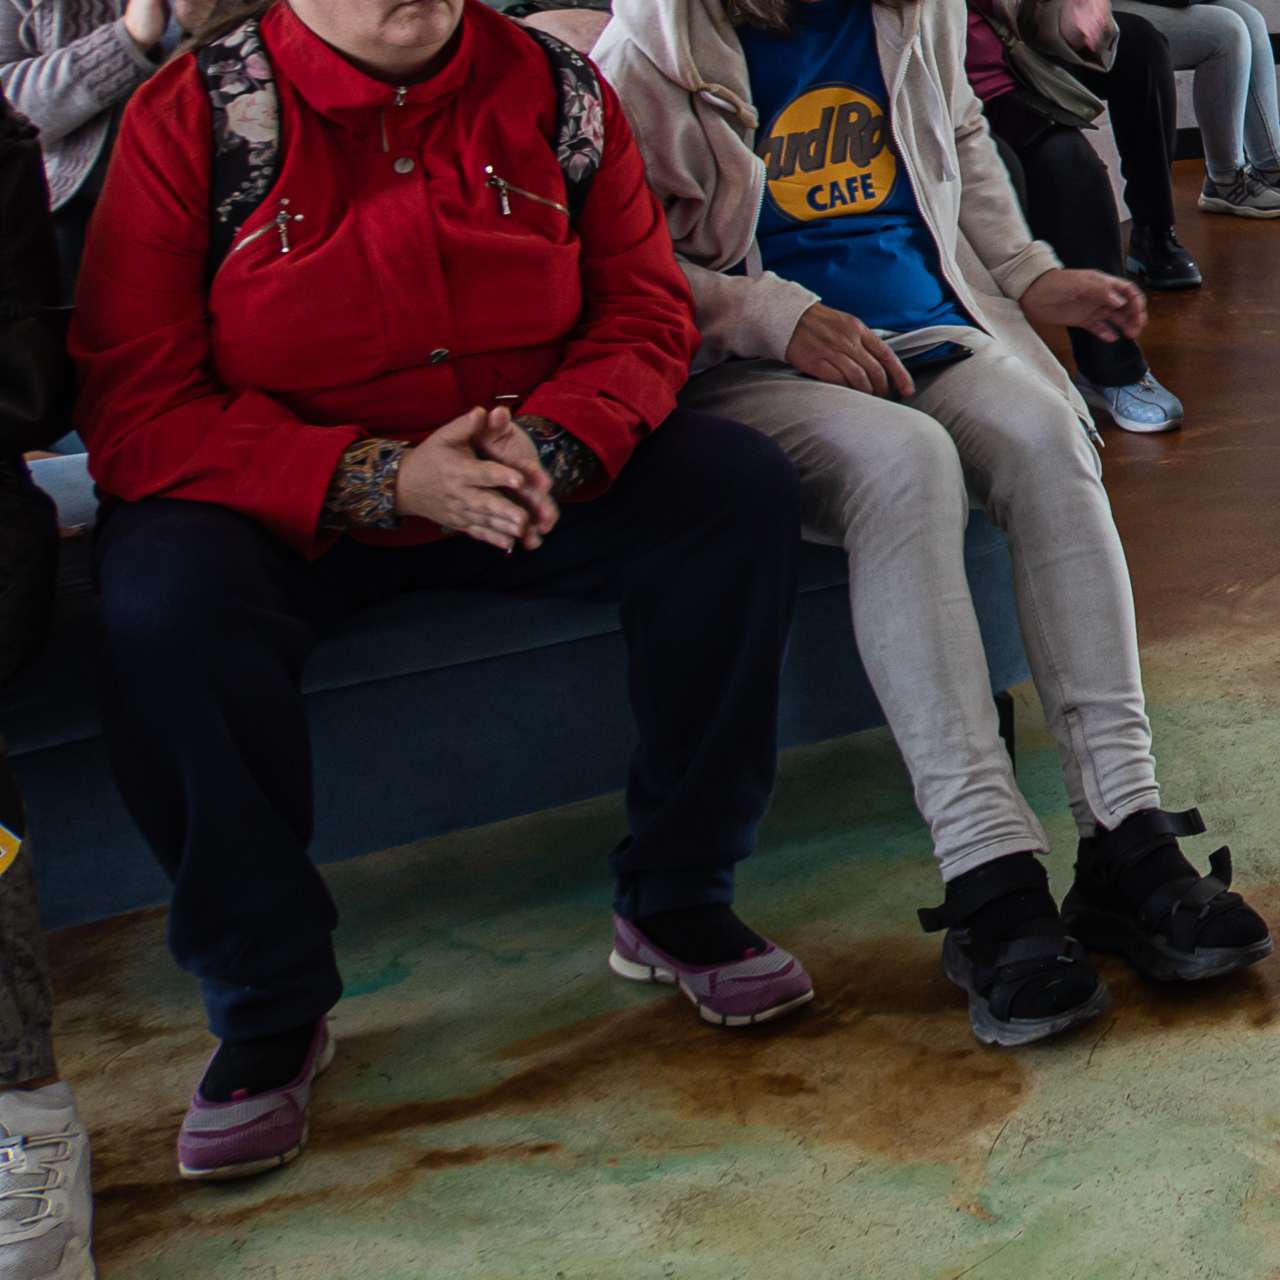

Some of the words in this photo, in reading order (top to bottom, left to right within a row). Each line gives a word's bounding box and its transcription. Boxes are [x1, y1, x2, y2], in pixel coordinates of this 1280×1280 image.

[755, 106, 834, 181] ard
[830, 101, 897, 168] Ro
[806, 173, 876, 211] CAFE
